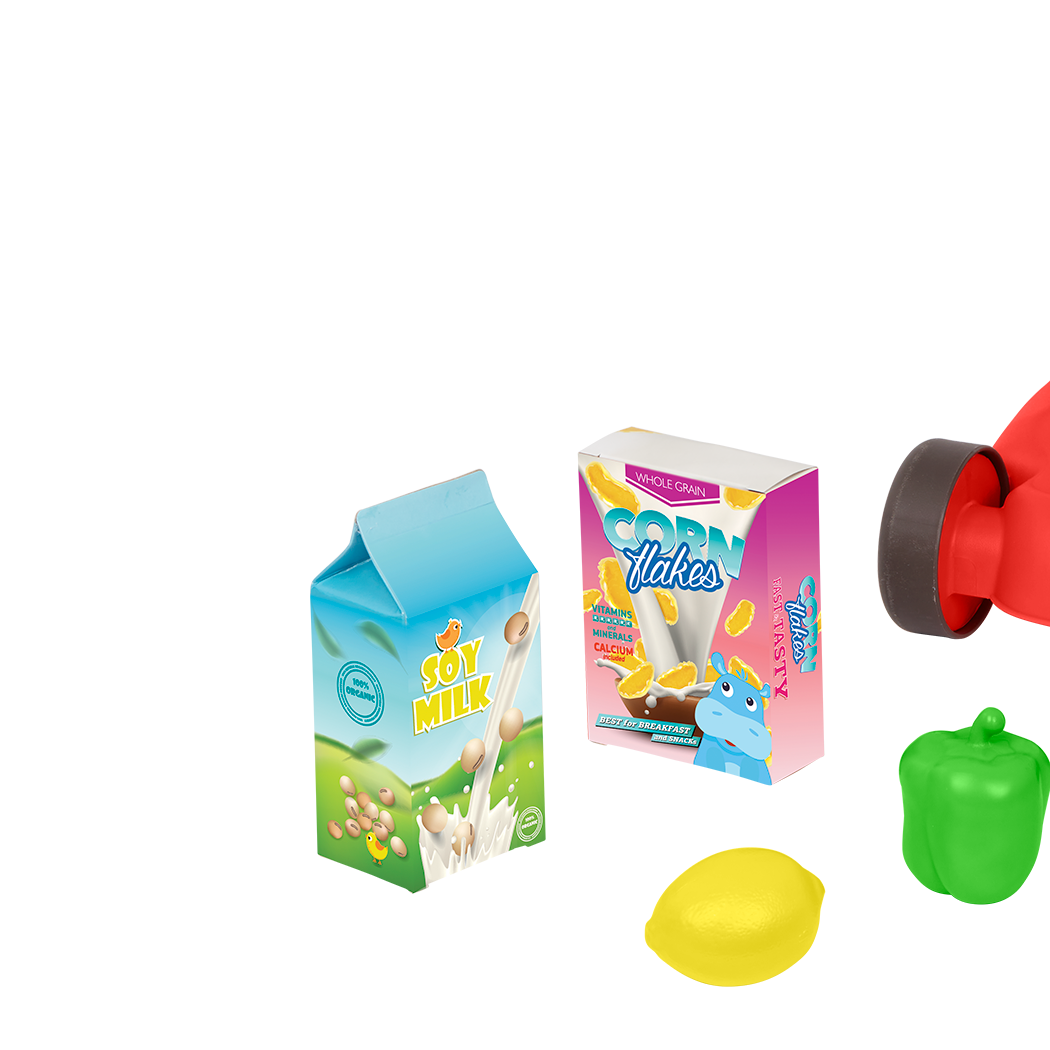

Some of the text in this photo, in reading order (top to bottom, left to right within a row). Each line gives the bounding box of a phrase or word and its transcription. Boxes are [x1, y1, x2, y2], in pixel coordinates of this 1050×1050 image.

[635, 471, 706, 497] WHOLE GRAIN
[603, 507, 746, 580] CORN
[623, 539, 724, 594] flakes
[591, 603, 633, 619] VITAMINS
[772, 576, 783, 612] FAST
[592, 628, 633, 643] MINERALS
[784, 593, 809, 665] flakes
[799, 575, 818, 674] CORN
[420, 635, 485, 694] SOY
[593, 642, 634, 657] CALCIUM
[773, 617, 789, 700] TASTY
[345, 685, 376, 704] ORGANIC
[352, 677, 369, 690] 100%
[412, 672, 495, 736] MILK
[599, 716, 691, 735] BEST for BREAKFAST
